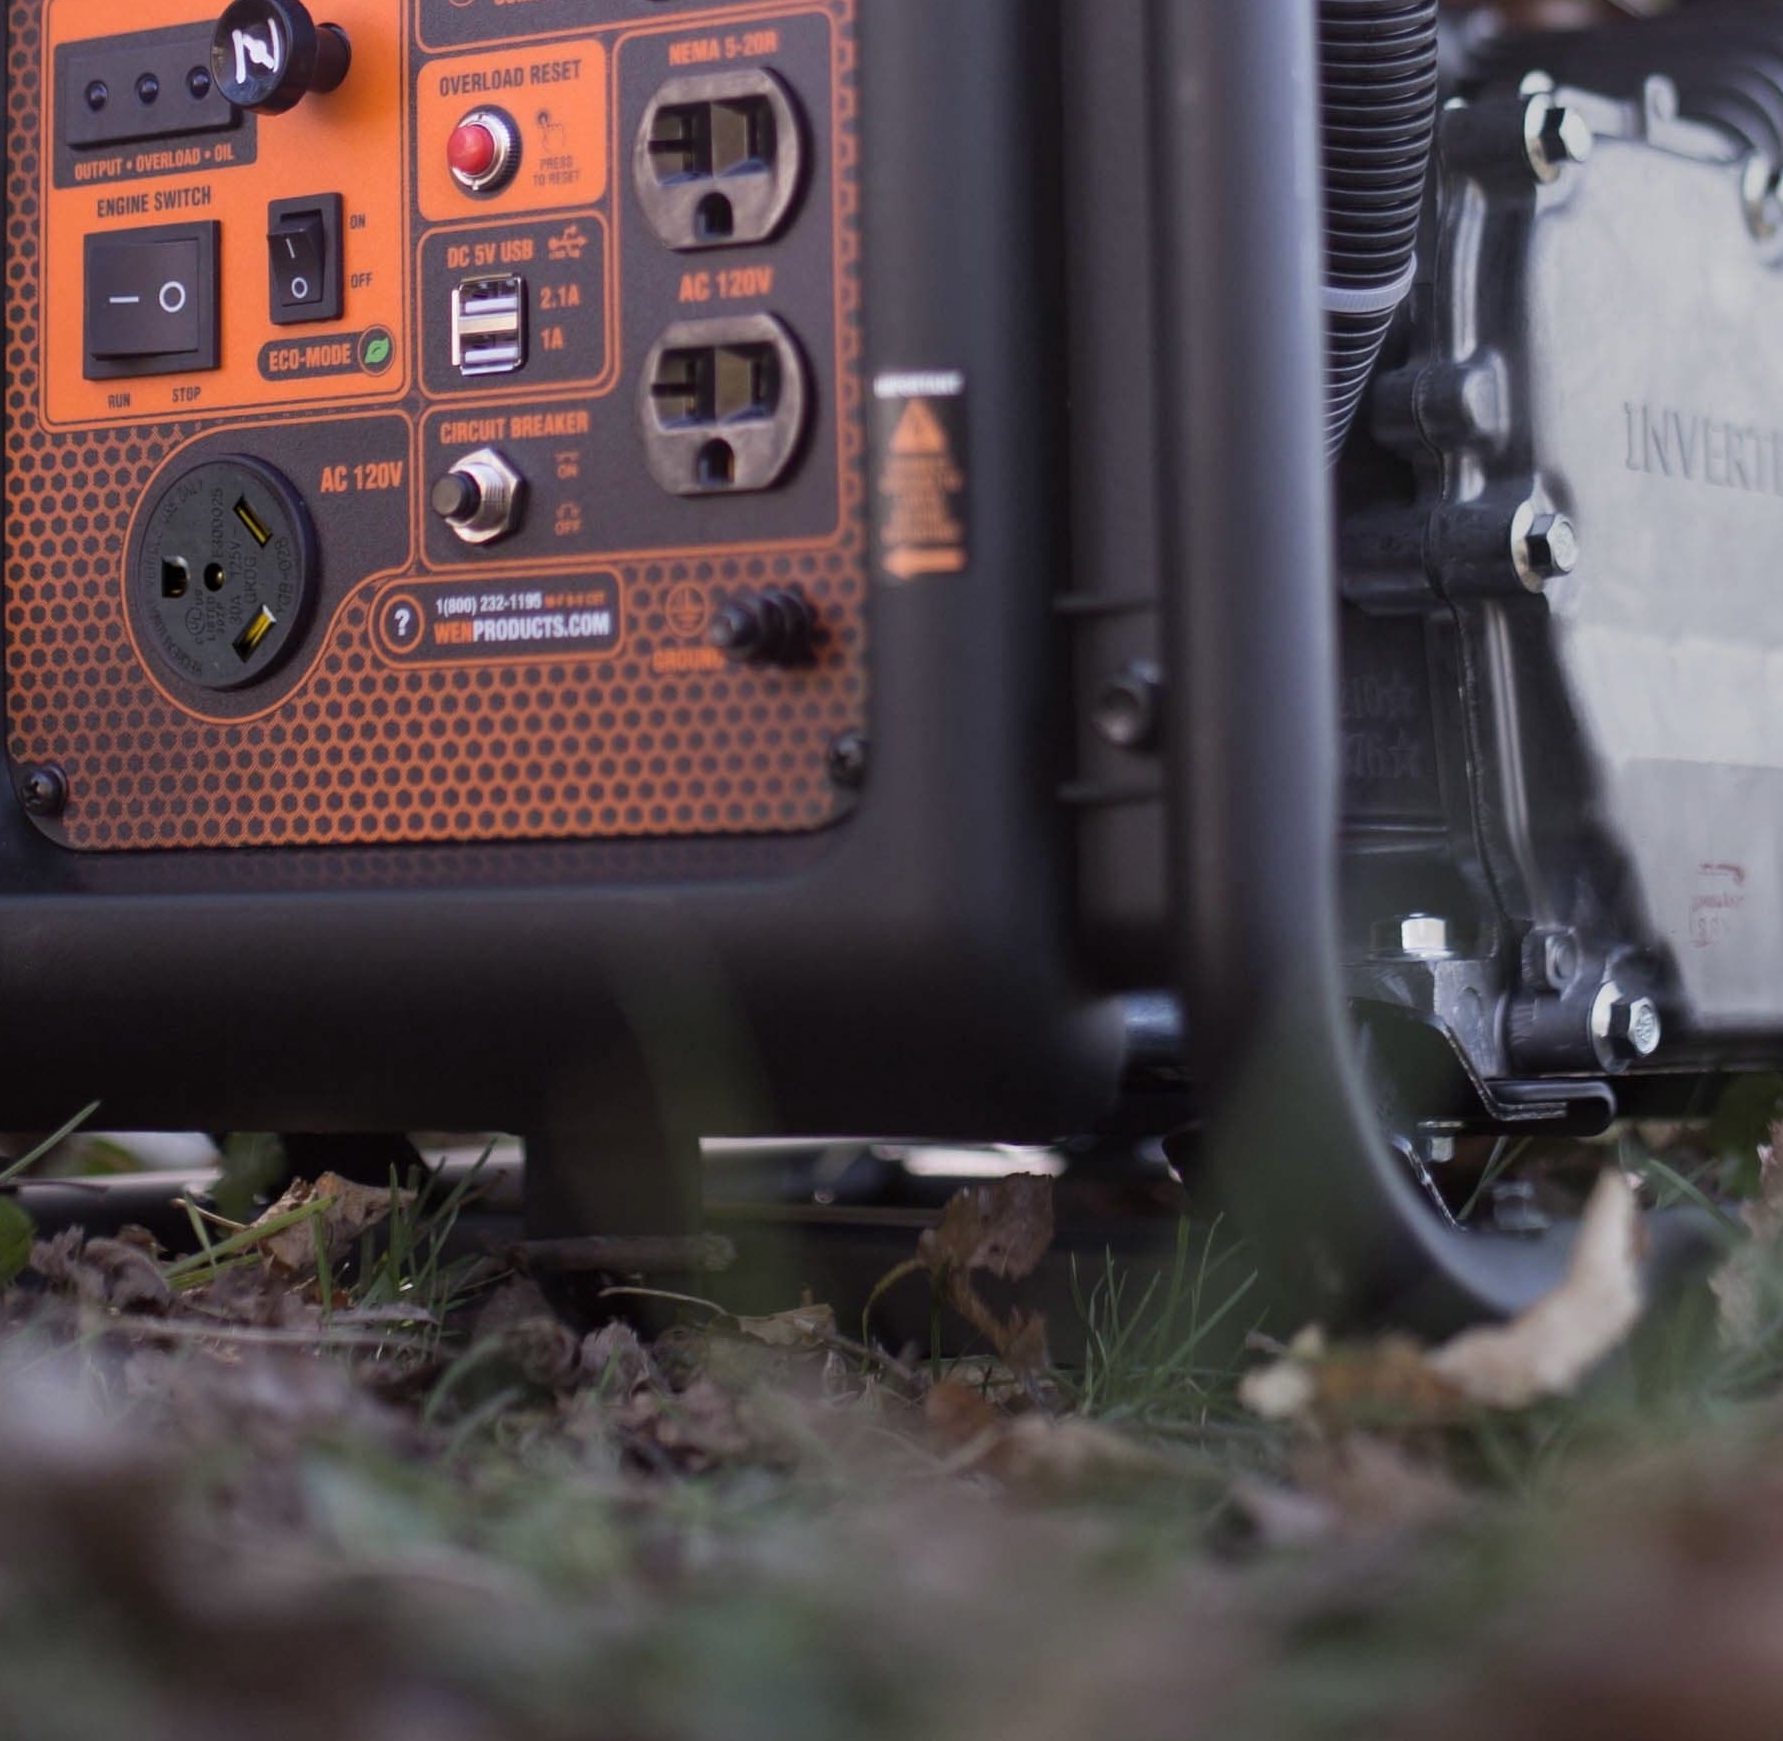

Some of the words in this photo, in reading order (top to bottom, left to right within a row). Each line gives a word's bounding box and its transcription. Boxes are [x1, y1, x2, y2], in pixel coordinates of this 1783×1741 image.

[668, 34, 721, 66] NEMA
[724, 27, 779, 58] 5-20R
[439, 66, 524, 98] OVERLOAD
[530, 59, 582, 87] RESET
[74, 157, 123, 182] OUTPUT
[136, 148, 201, 175] OVERLOAD
[214, 144, 235, 164] OIL
[97, 189, 150, 219] ENGINE
[154, 185, 212, 212] SWITCH
[349, 214, 366, 230] ON
[447, 245, 472, 270] DC
[474, 242, 497, 267] 5V
[500, 238, 534, 264] USB
[350, 272, 373, 290] OFF
[539, 282, 581, 310] 2.1A
[679, 272, 712, 304] AC
[717, 266, 775, 299] 120V
[541, 326, 565, 351] 1A
[268, 342, 352, 373] ECO-MODE
[107, 394, 131, 409] RUN
[172, 386, 202, 403] STOP
[439, 416, 507, 445] CIRCUIT
[510, 409, 589, 441] BREAKER
[320, 465, 349, 494] AC
[352, 459, 403, 491] 120V
[556, 464, 579, 481] ON
[554, 518, 583, 537] OFF
[435, 594, 477, 618] 1(800)
[434, 611, 611, 645] WENPRODUCTS.COM
